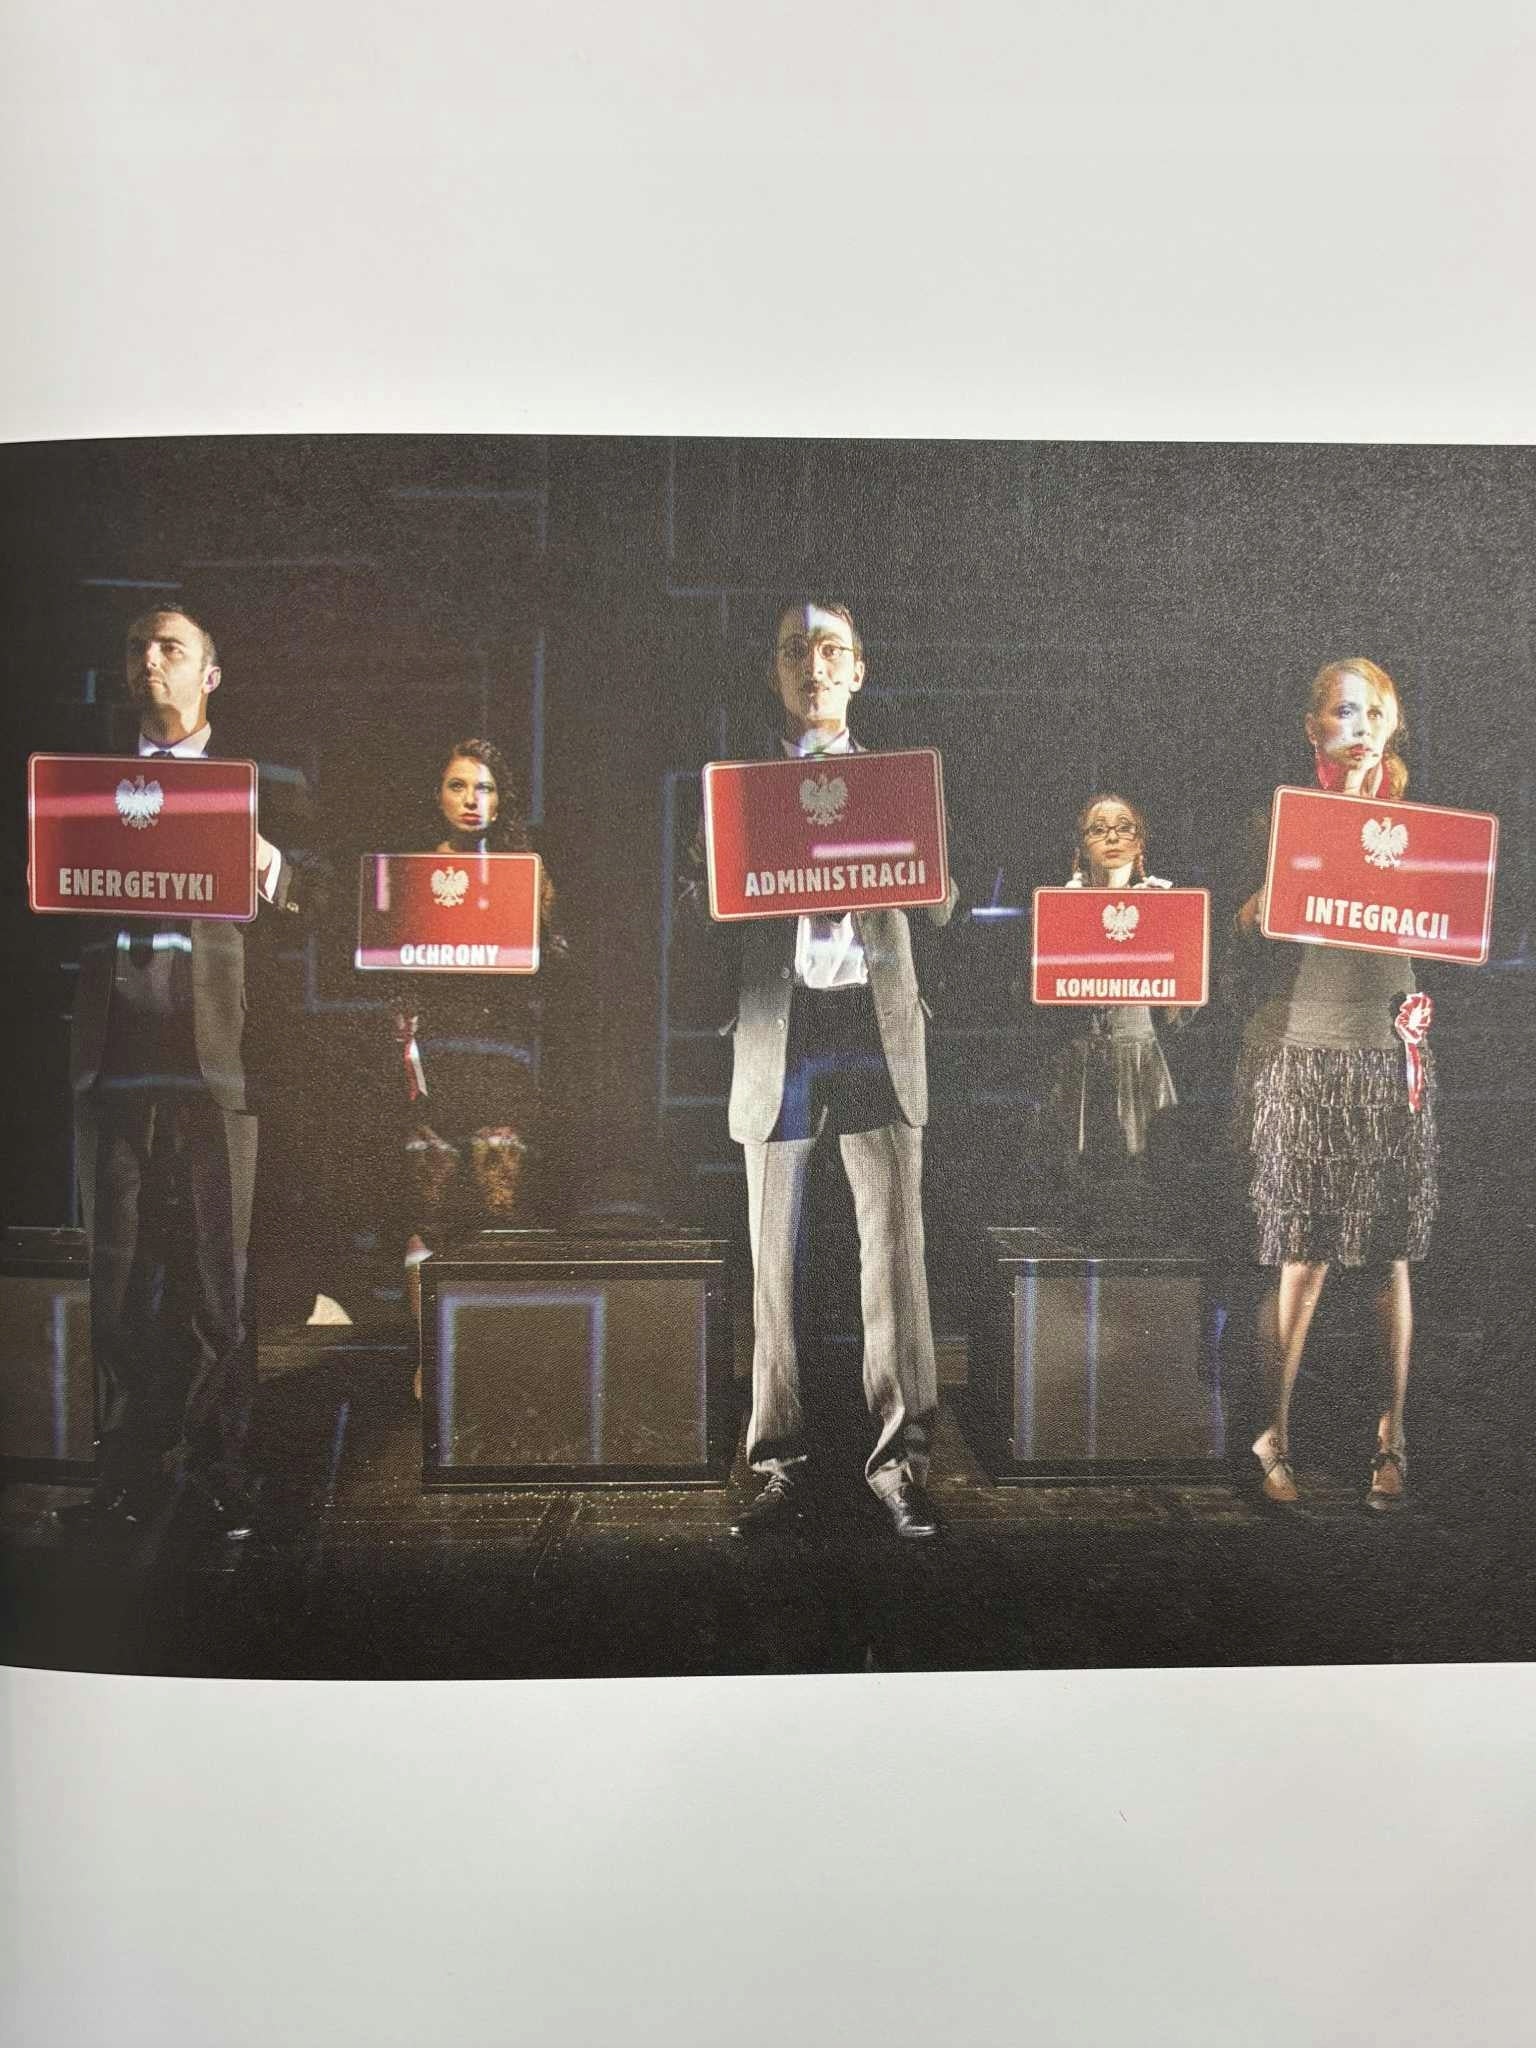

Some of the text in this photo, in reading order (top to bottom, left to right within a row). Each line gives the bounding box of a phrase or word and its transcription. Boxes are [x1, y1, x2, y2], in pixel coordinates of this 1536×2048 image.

[59, 868, 214, 901] ENERGETYKI
[745, 860, 926, 898] ADMINISTRACJI
[1305, 896, 1449, 940] INTEGRACJI
[399, 944, 499, 966] OCHRONY
[1055, 978, 1175, 999] KOMUNIKACJI
